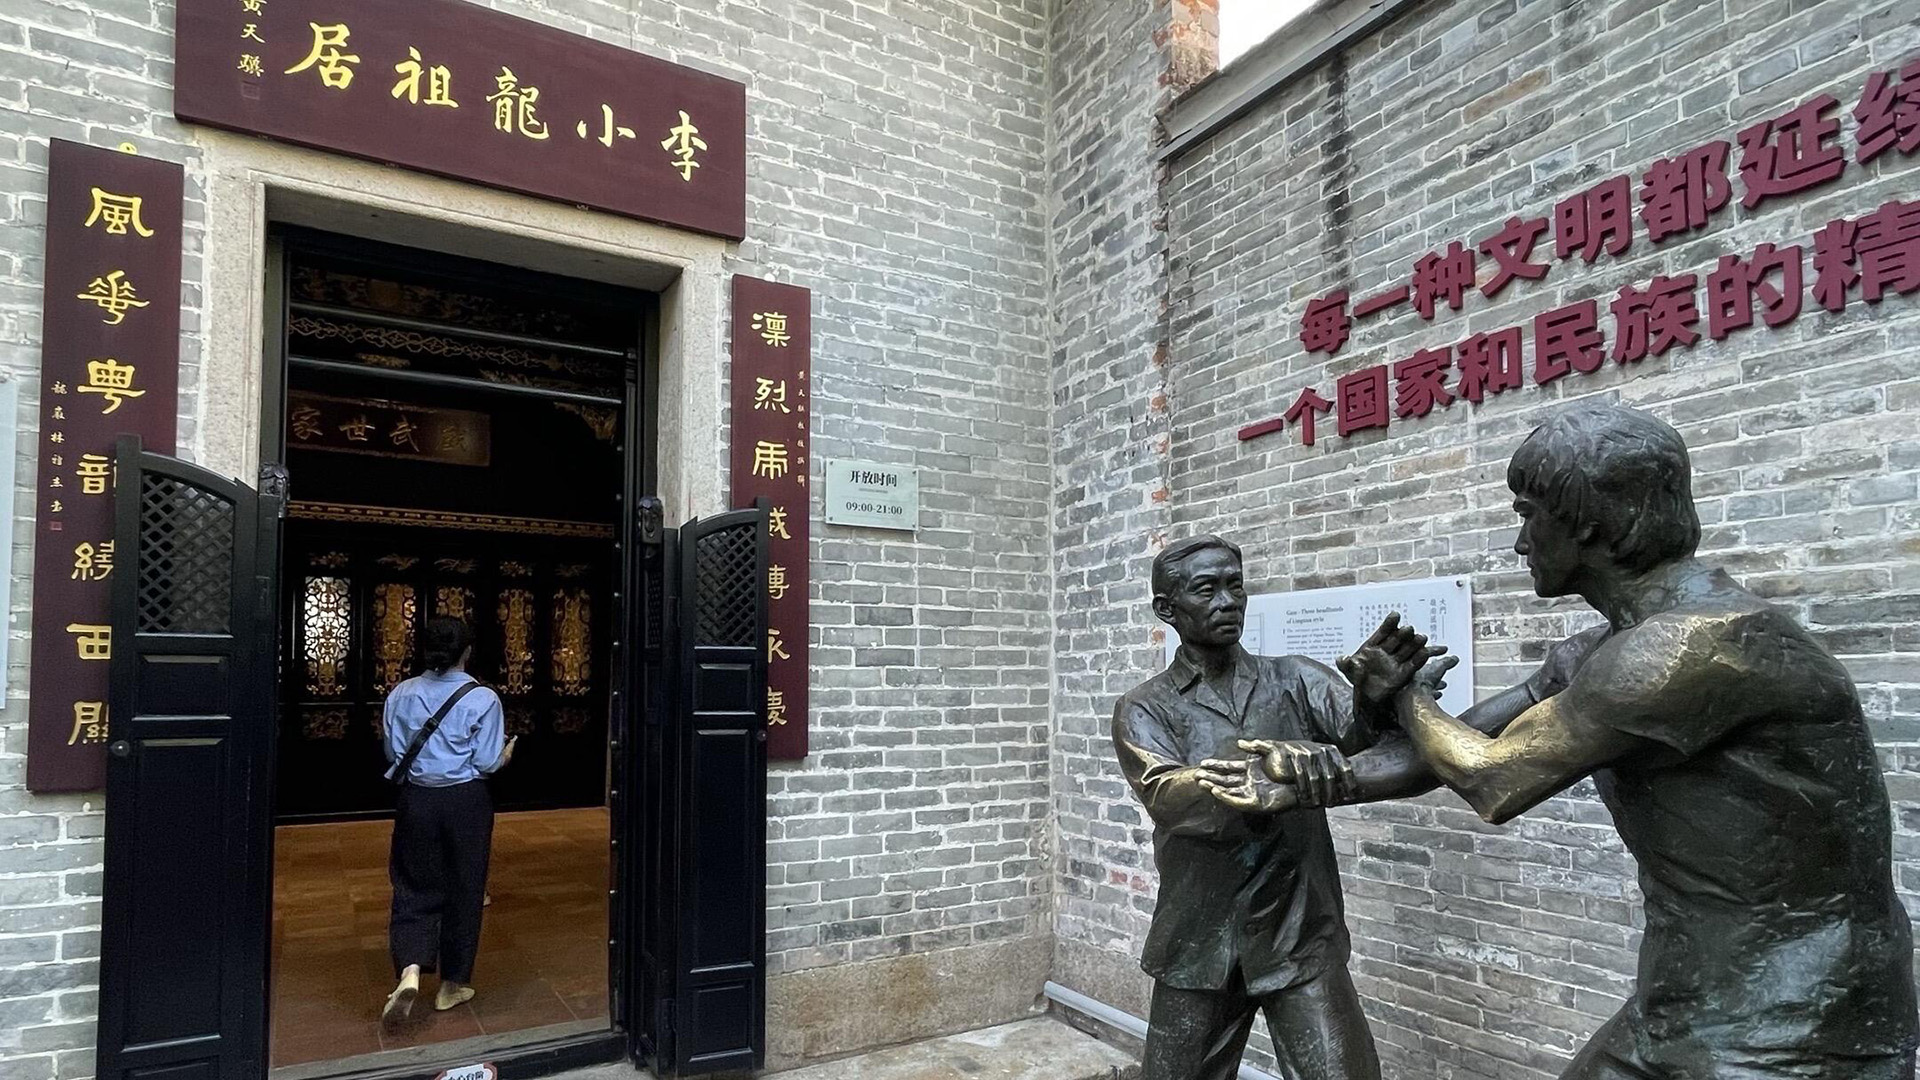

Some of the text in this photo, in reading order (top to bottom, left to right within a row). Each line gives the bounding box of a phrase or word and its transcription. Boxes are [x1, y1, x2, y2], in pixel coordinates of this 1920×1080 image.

[284, 21, 708, 182] 李小龍祖居
[1238, 198, 1920, 446] 一个国家和民族的精
[846, 502, 903, 515] 09:00-21:00
[849, 470, 897, 487] 开放时间
